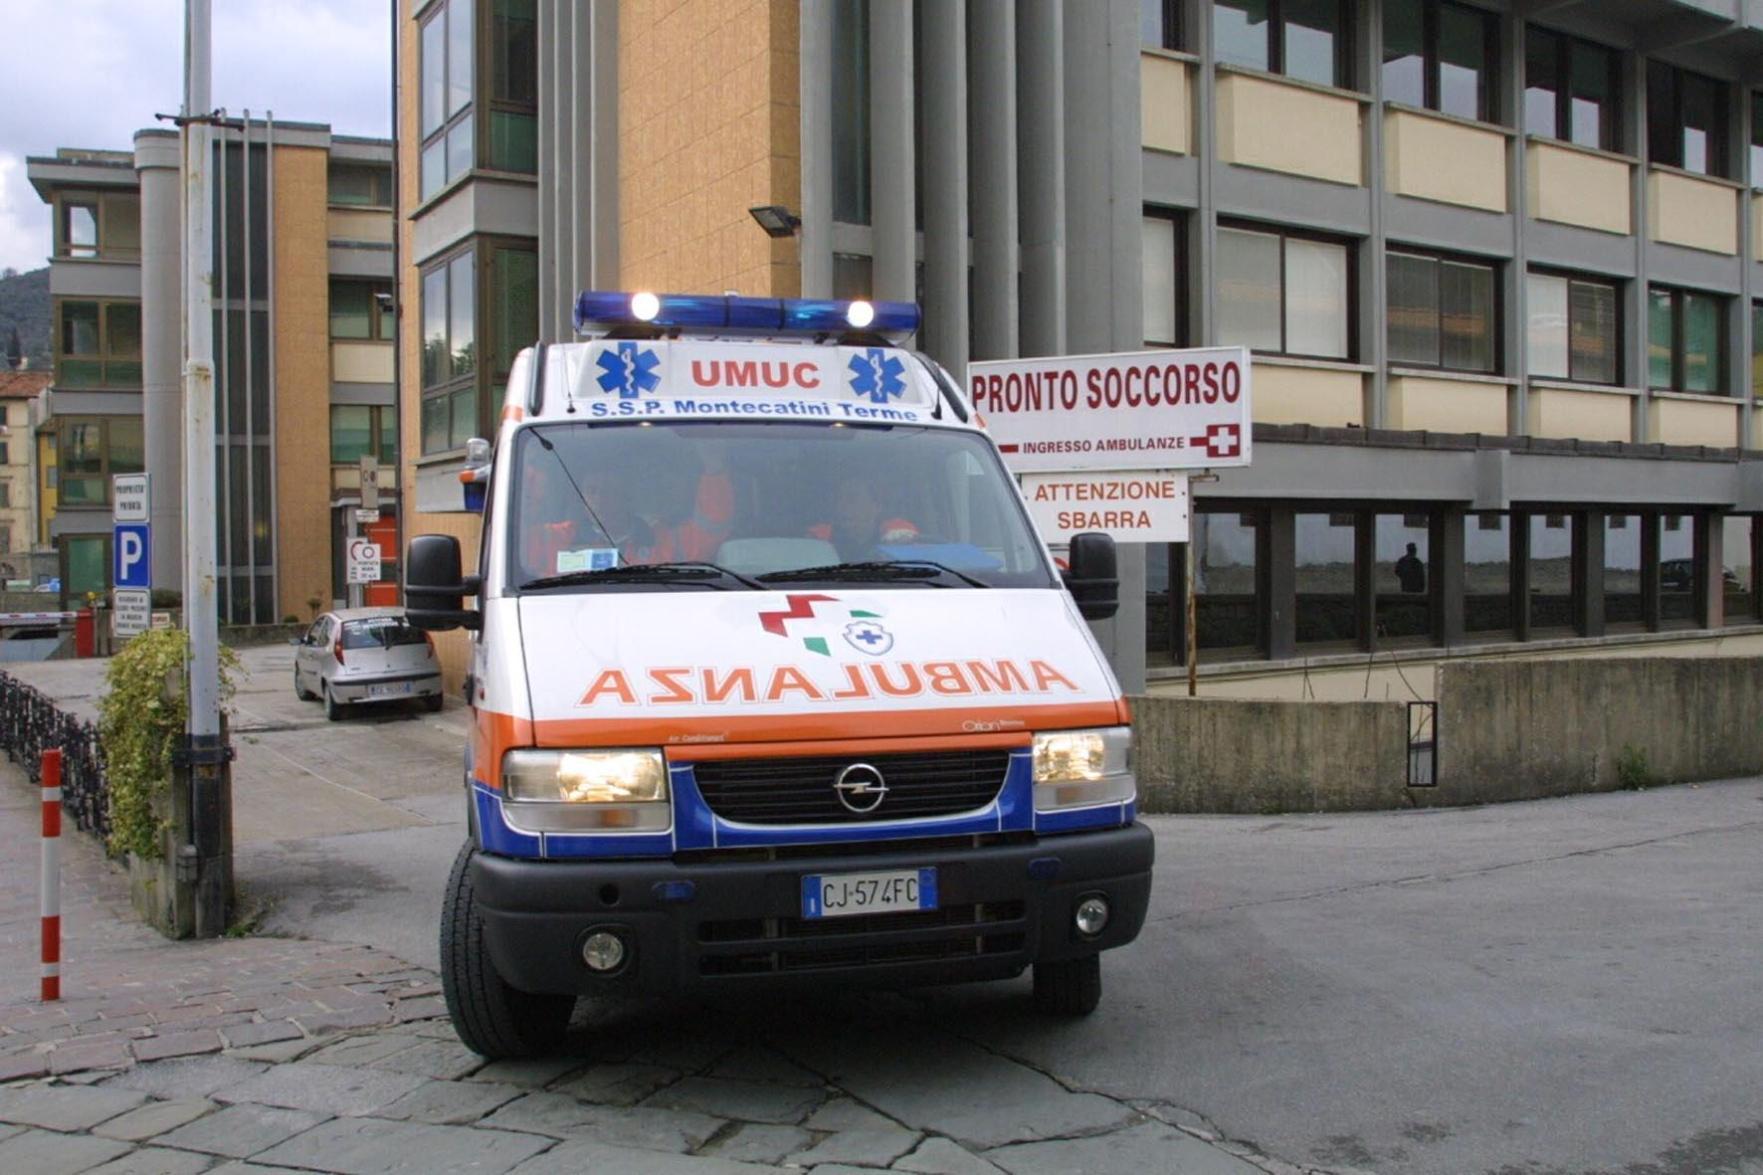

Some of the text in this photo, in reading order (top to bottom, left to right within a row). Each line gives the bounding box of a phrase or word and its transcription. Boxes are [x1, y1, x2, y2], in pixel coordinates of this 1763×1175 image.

[691, 360, 821, 389] UMUC
[972, 361, 1241, 413] PRONTO SOCCORSO
[592, 400, 919, 422] S.S.P. Montecatini Terme
[1023, 437, 1185, 454] INGRESSO AMBULANZE
[1035, 481, 1176, 501] ATTENZIONE
[1058, 511, 1152, 529] SBARRA
[121, 532, 142, 580] P
